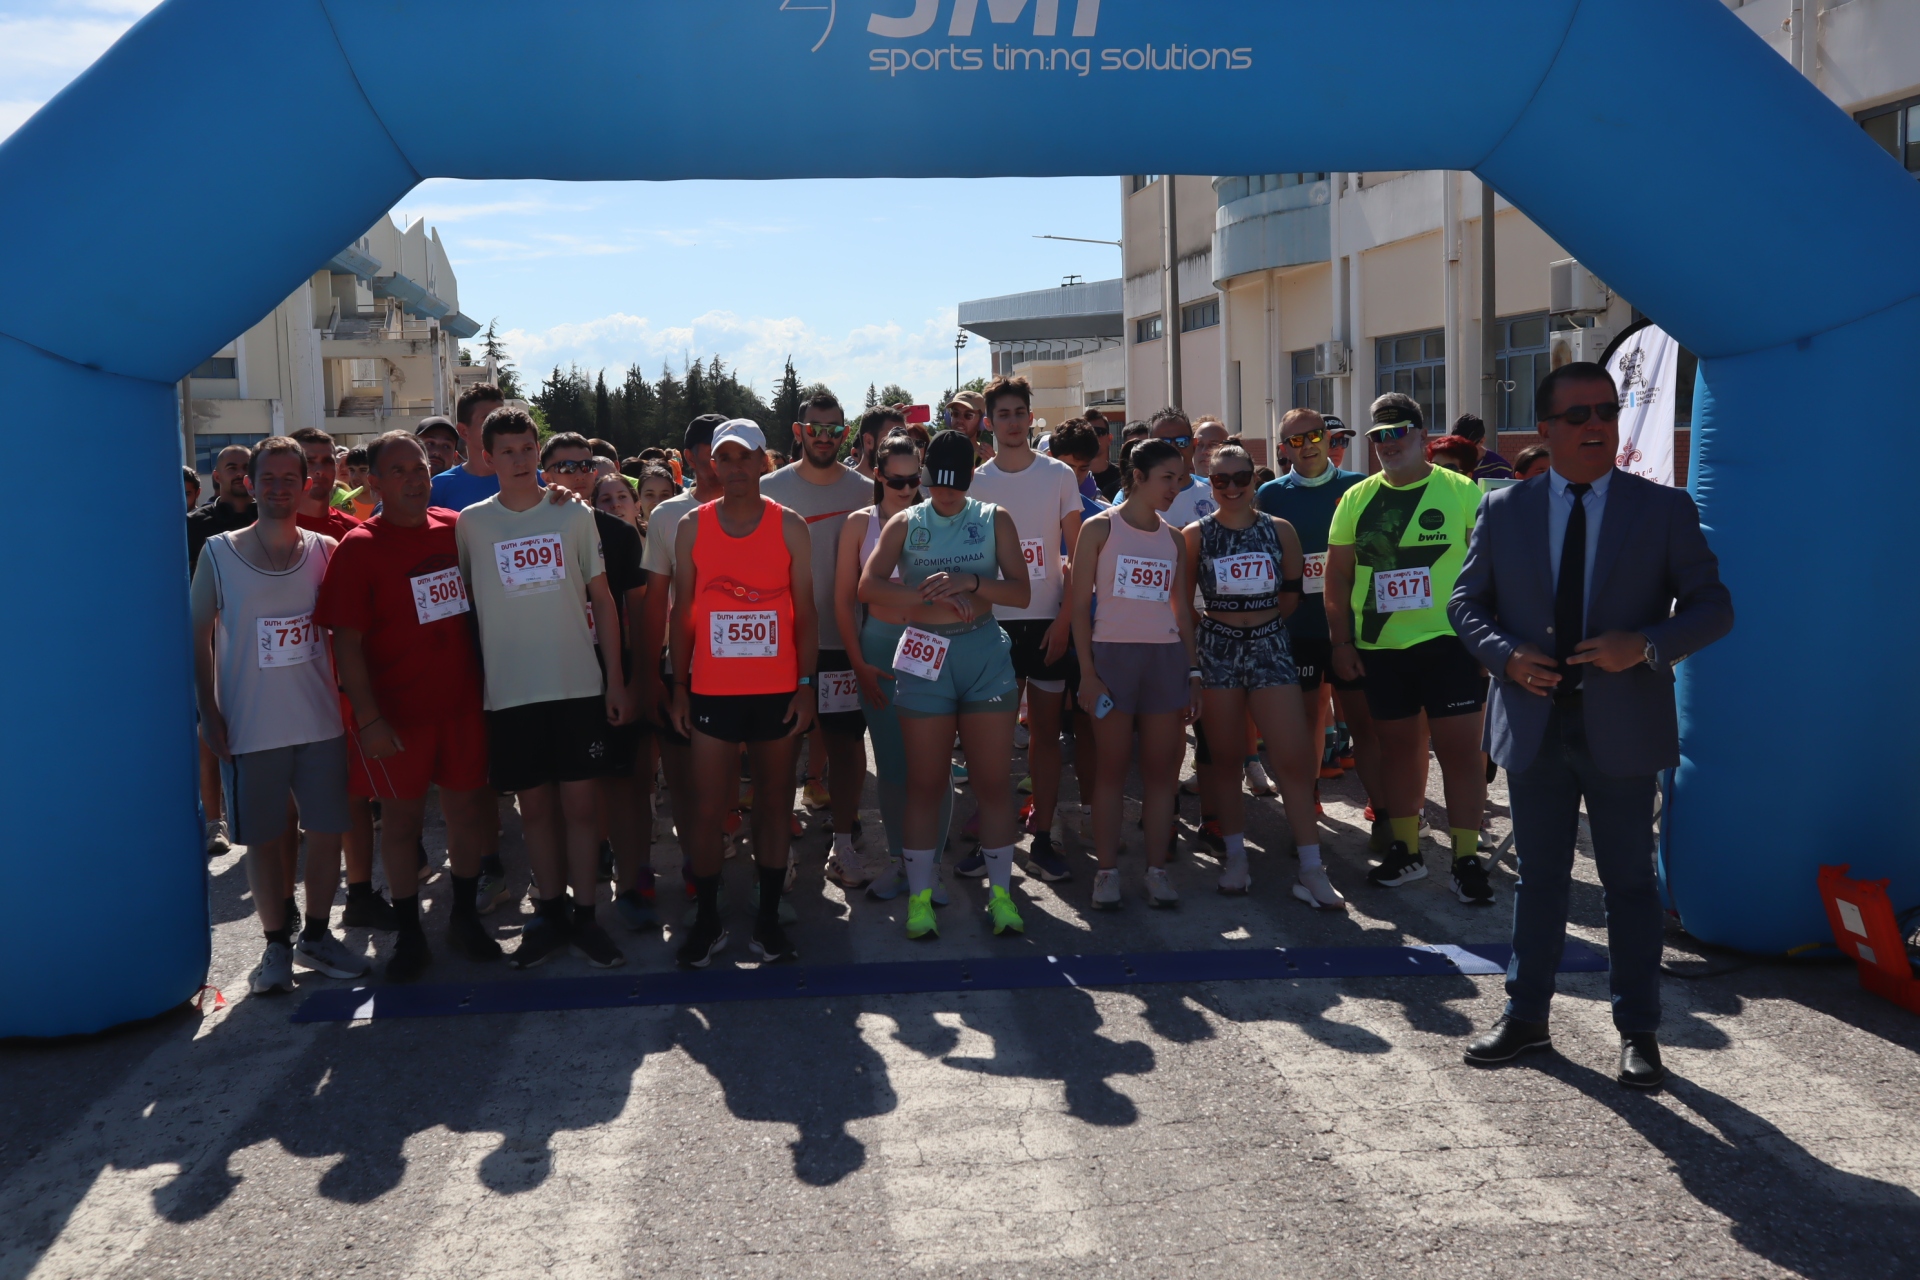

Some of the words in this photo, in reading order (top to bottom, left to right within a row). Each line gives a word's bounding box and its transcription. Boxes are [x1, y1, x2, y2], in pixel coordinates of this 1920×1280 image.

[868, 43, 982, 77] sports
[1101, 43, 1253, 71] solutions
[1418, 531, 1447, 542] bwin
[514, 546, 552, 568] 509
[914, 557, 952, 566] ΔΡΟΜΙΚΗ
[954, 552, 985, 563] ΟΜΑΔΑ
[1131, 567, 1163, 587] 593
[1230, 561, 1263, 578] 677
[1303, 562, 1326, 577] 69
[429, 580, 458, 603] 508
[1387, 578, 1420, 597] 617
[1210, 601, 1239, 610] PRO
[1244, 598, 1273, 609] NIKE
[276, 623, 310, 647] 737
[728, 623, 766, 641] 550
[1212, 624, 1244, 638] PRO
[1250, 621, 1279, 638] NIKE
[902, 638, 934, 662] 569
